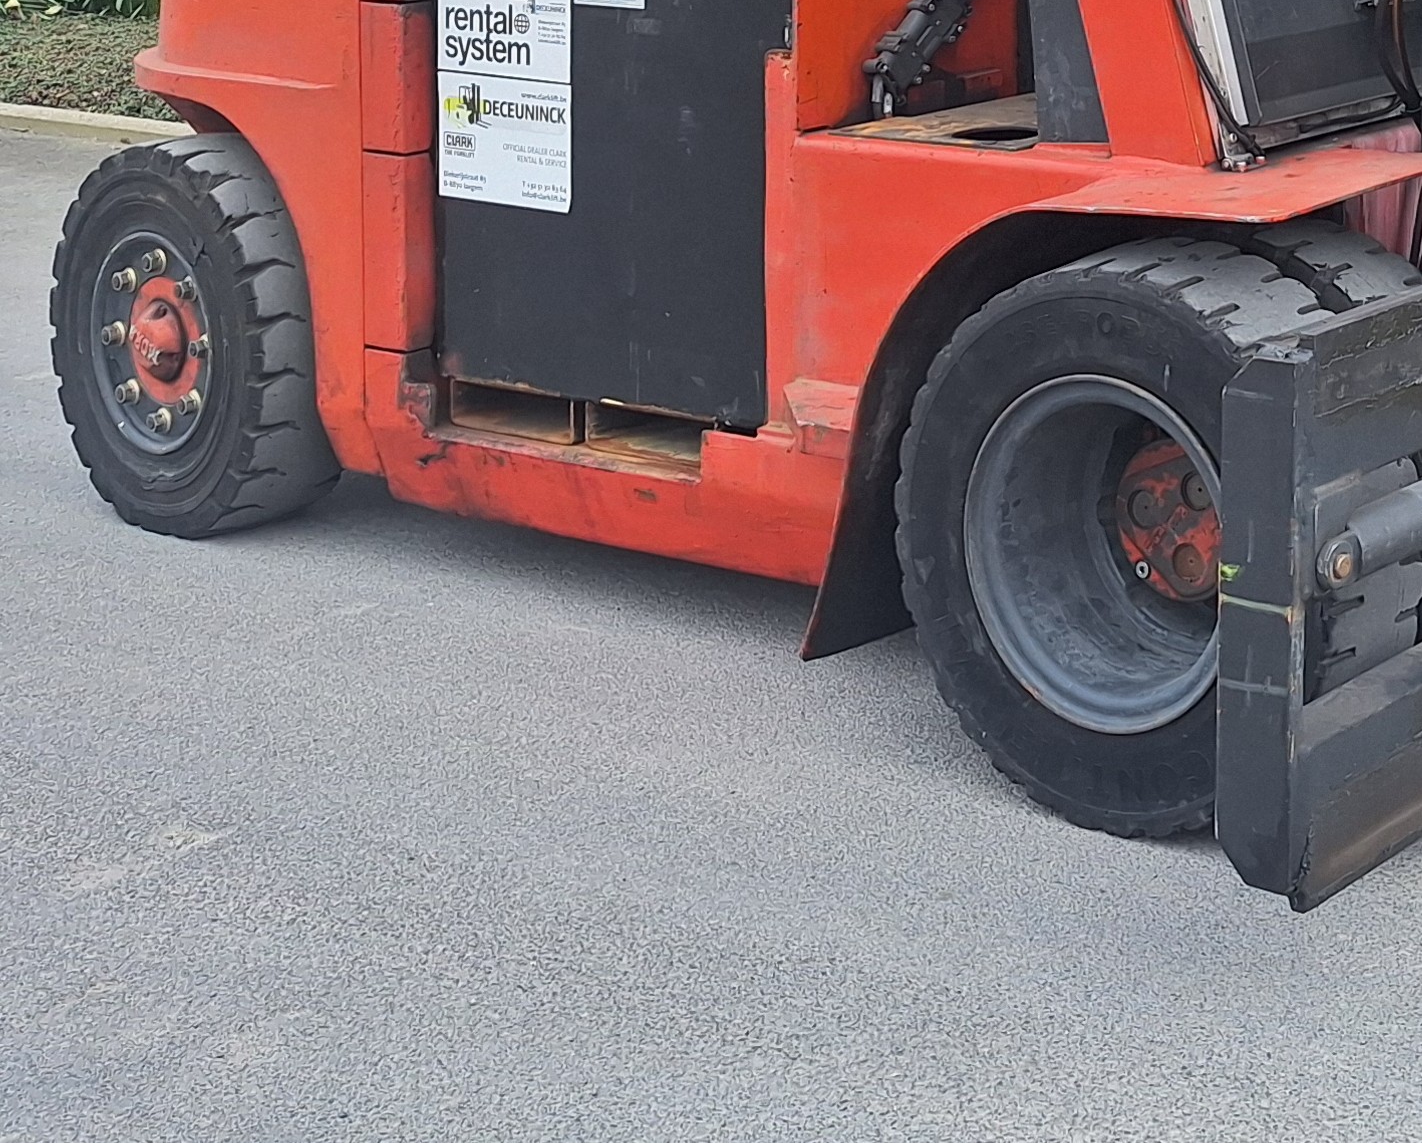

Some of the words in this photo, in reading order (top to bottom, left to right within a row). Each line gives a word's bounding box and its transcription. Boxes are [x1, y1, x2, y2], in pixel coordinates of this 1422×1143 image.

[445, 4, 513, 35] rental
[445, 33, 531, 66] system
[482, 99, 566, 125] DECEUNINCK
[446, 134, 473, 149] CLARK
[503, 143, 526, 153] OFFICIAL
[527, 146, 548, 156] DEALER
[549, 148, 567, 157] CLARK
[517, 156, 537, 164] RENTAL
[544, 158, 566, 168] SERVICE
